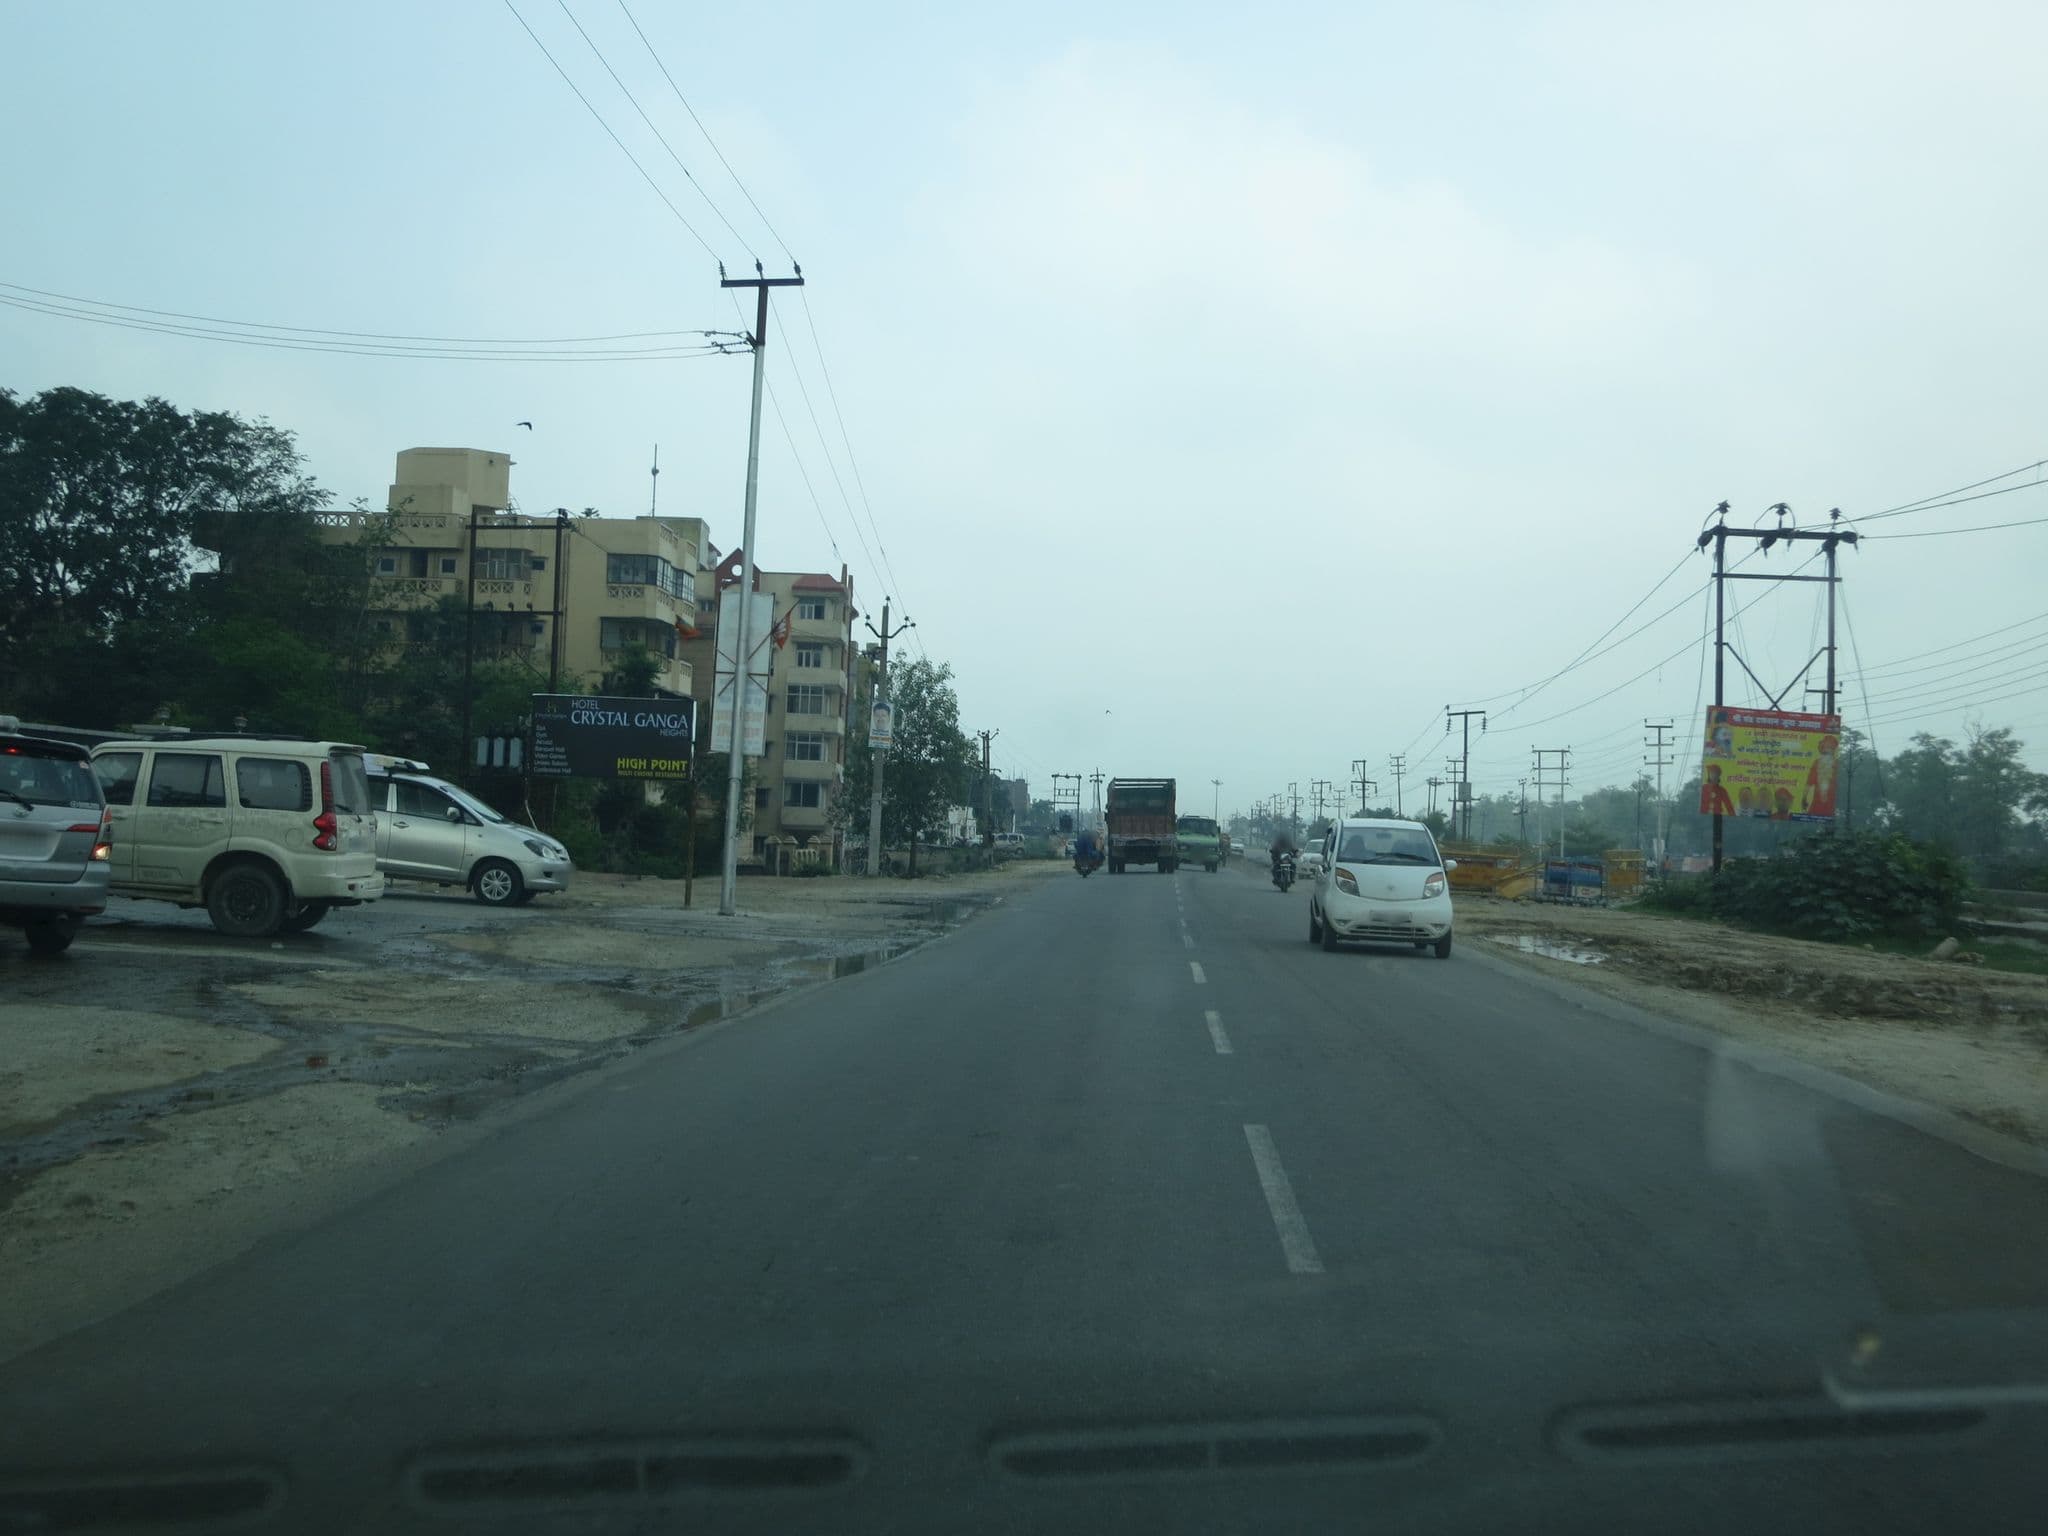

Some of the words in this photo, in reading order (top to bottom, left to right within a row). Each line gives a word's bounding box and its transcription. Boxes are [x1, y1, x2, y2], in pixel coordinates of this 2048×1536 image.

[571, 699, 600, 710] HOTEL
[571, 710, 630, 726] CRYSTAL
[634, 712, 688, 729] GANGA
[659, 728, 689, 737] HEIGHTS
[617, 757, 647, 769] HIGH
[650, 759, 688, 771] POINT
